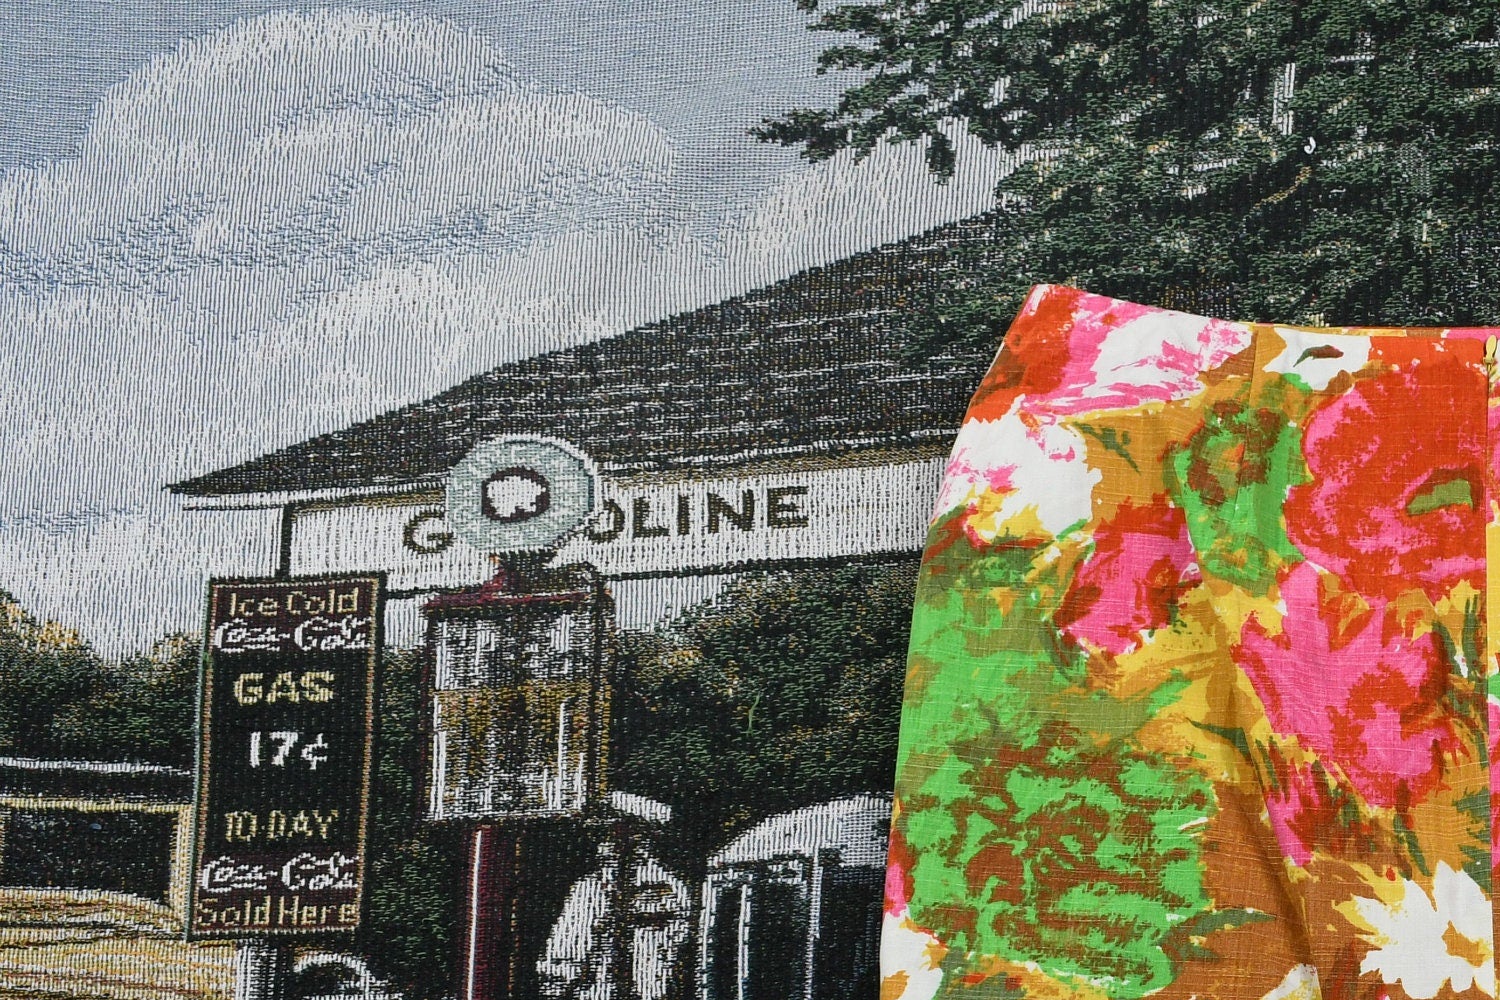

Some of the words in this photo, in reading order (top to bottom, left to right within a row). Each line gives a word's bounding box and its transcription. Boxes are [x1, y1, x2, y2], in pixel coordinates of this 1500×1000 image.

[402, 485, 809, 556] GOLINE
[229, 591, 280, 618] Ice
[286, 587, 360, 616] Cold
[234, 670, 335, 706] GAS
[199, 895, 272, 927] Sold
[278, 895, 357, 926] Here
